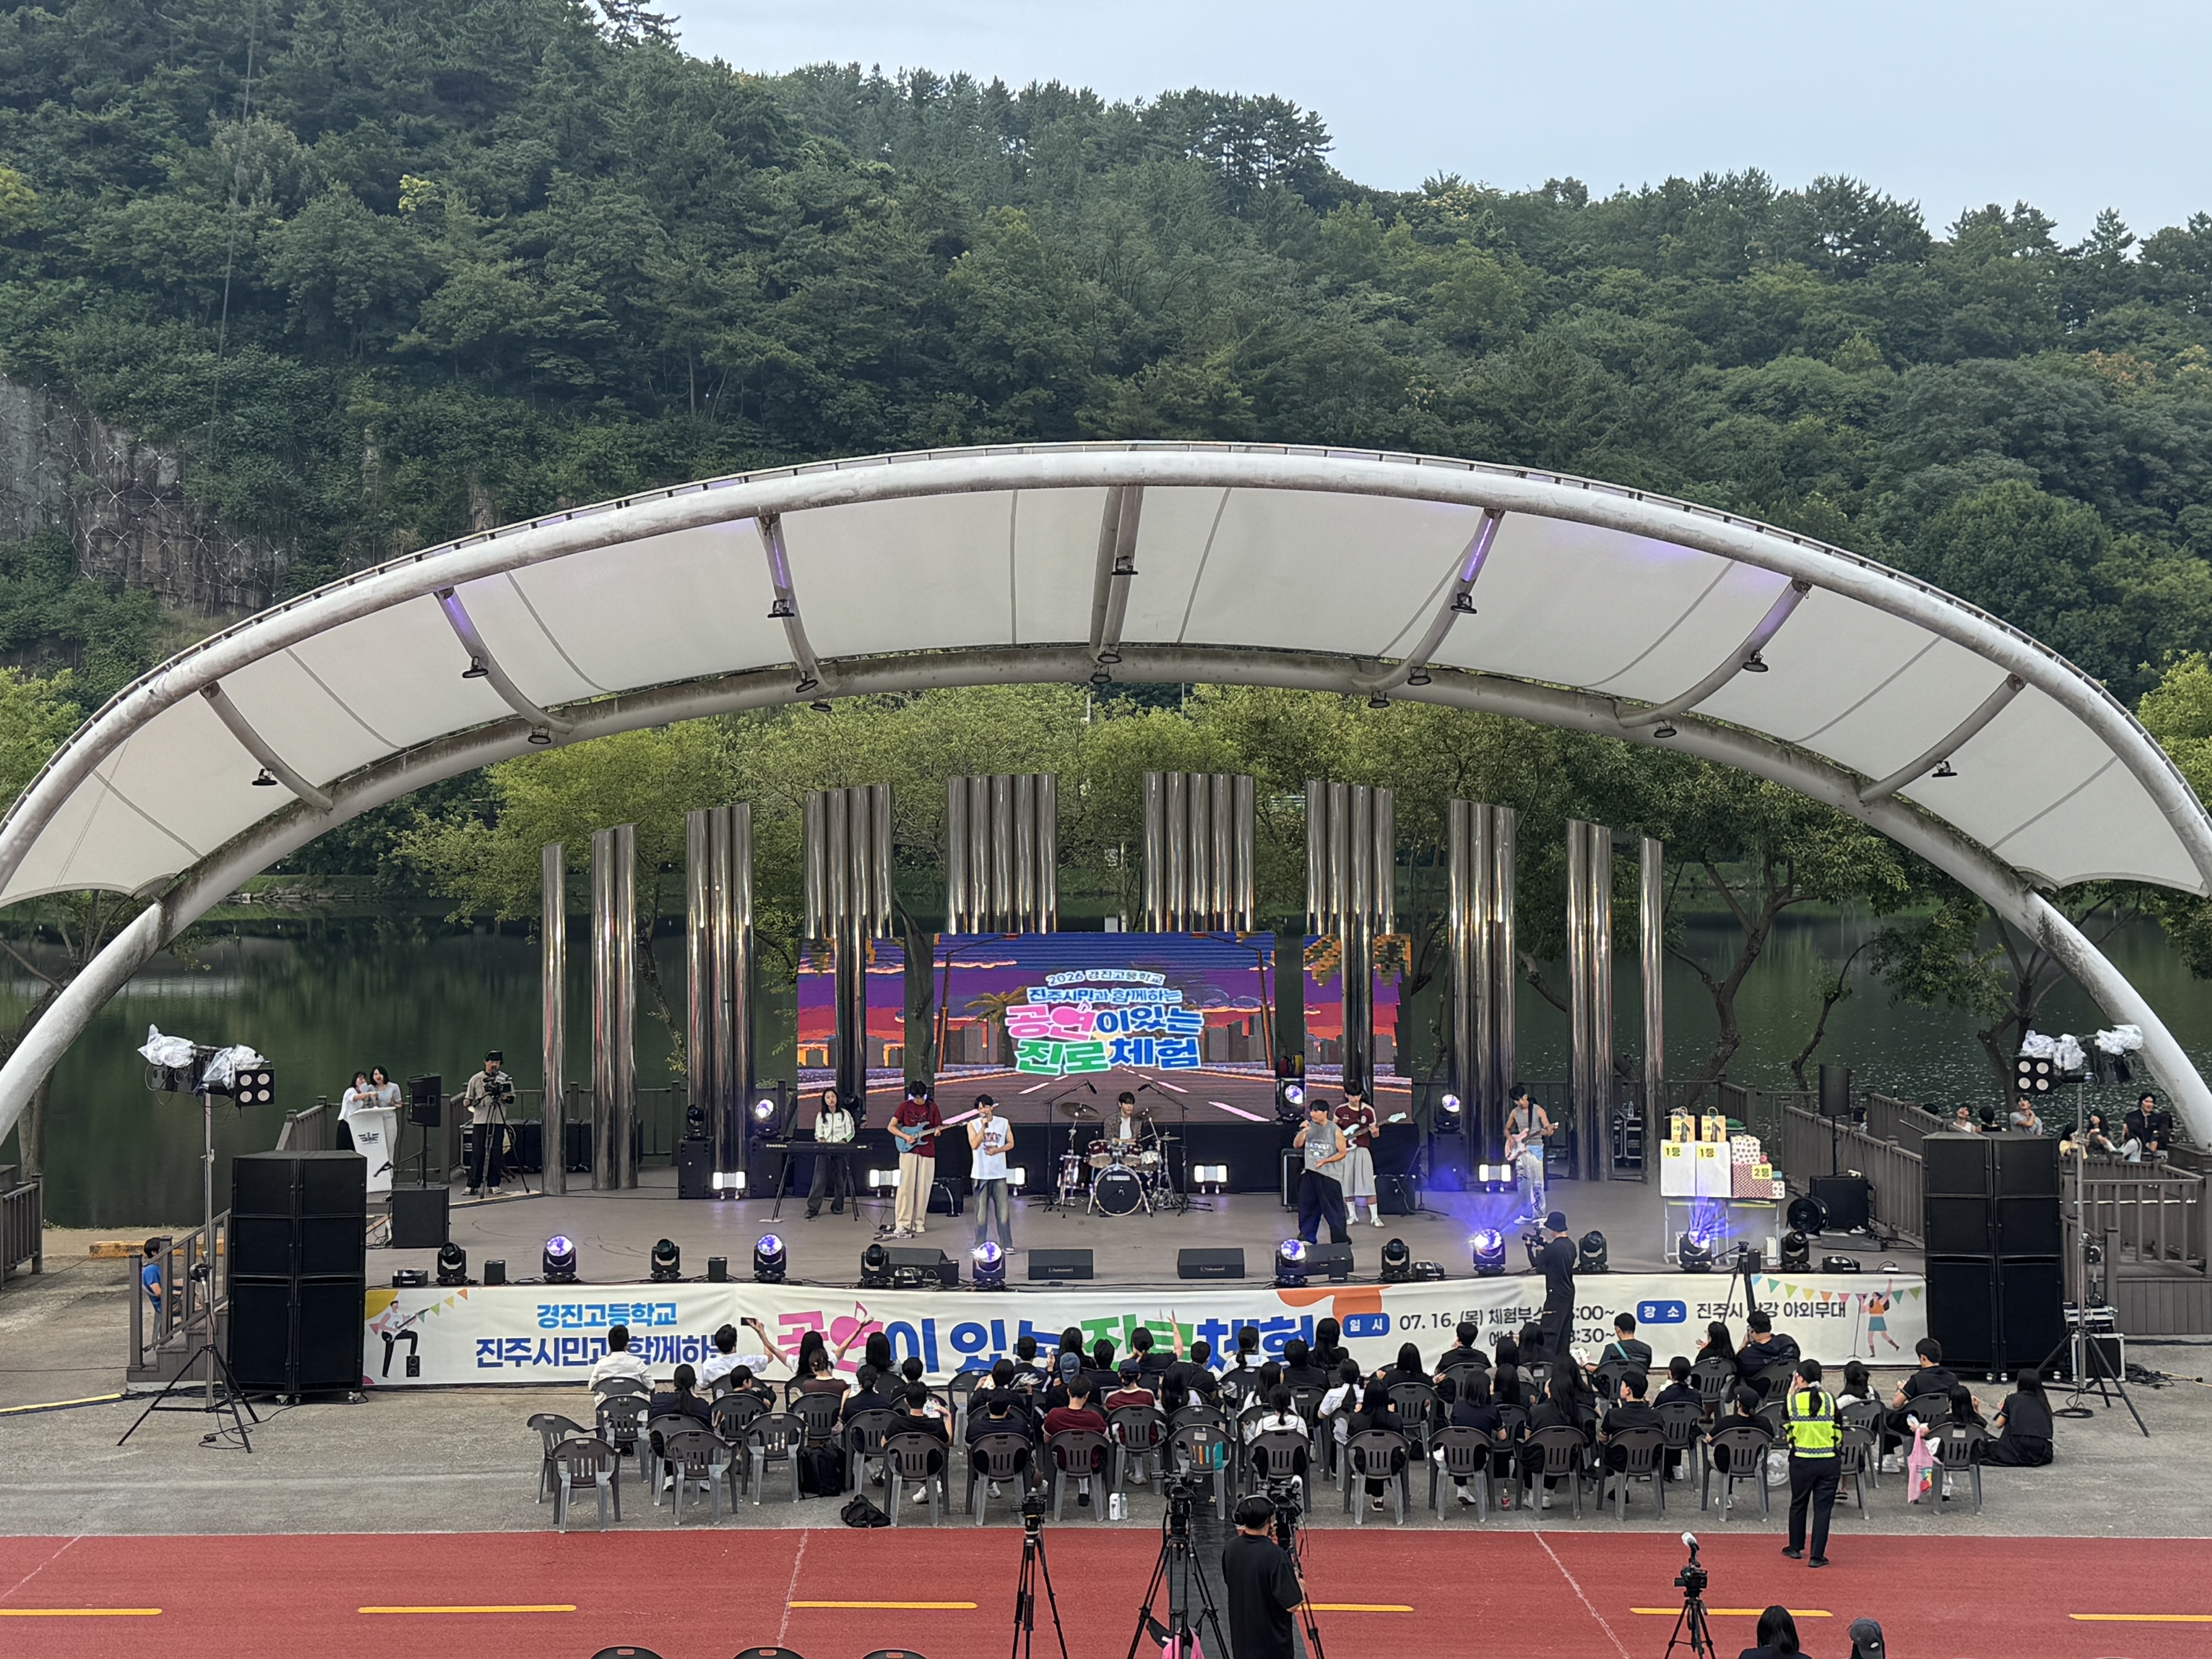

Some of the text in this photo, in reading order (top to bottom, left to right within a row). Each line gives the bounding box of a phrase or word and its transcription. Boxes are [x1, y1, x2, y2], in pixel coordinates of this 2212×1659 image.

[1047, 972, 1084, 985] 2026
[1029, 988, 1181, 1003] 진주시민과 함께하는
[1017, 1038, 1201, 1075] 진로체험
[537, 1302, 678, 1329] 경진고등학교
[1697, 1302, 1742, 1319] 진주시
[1783, 1301, 1846, 1318] 야외무대
[627, 1334, 721, 1365] 함께하
